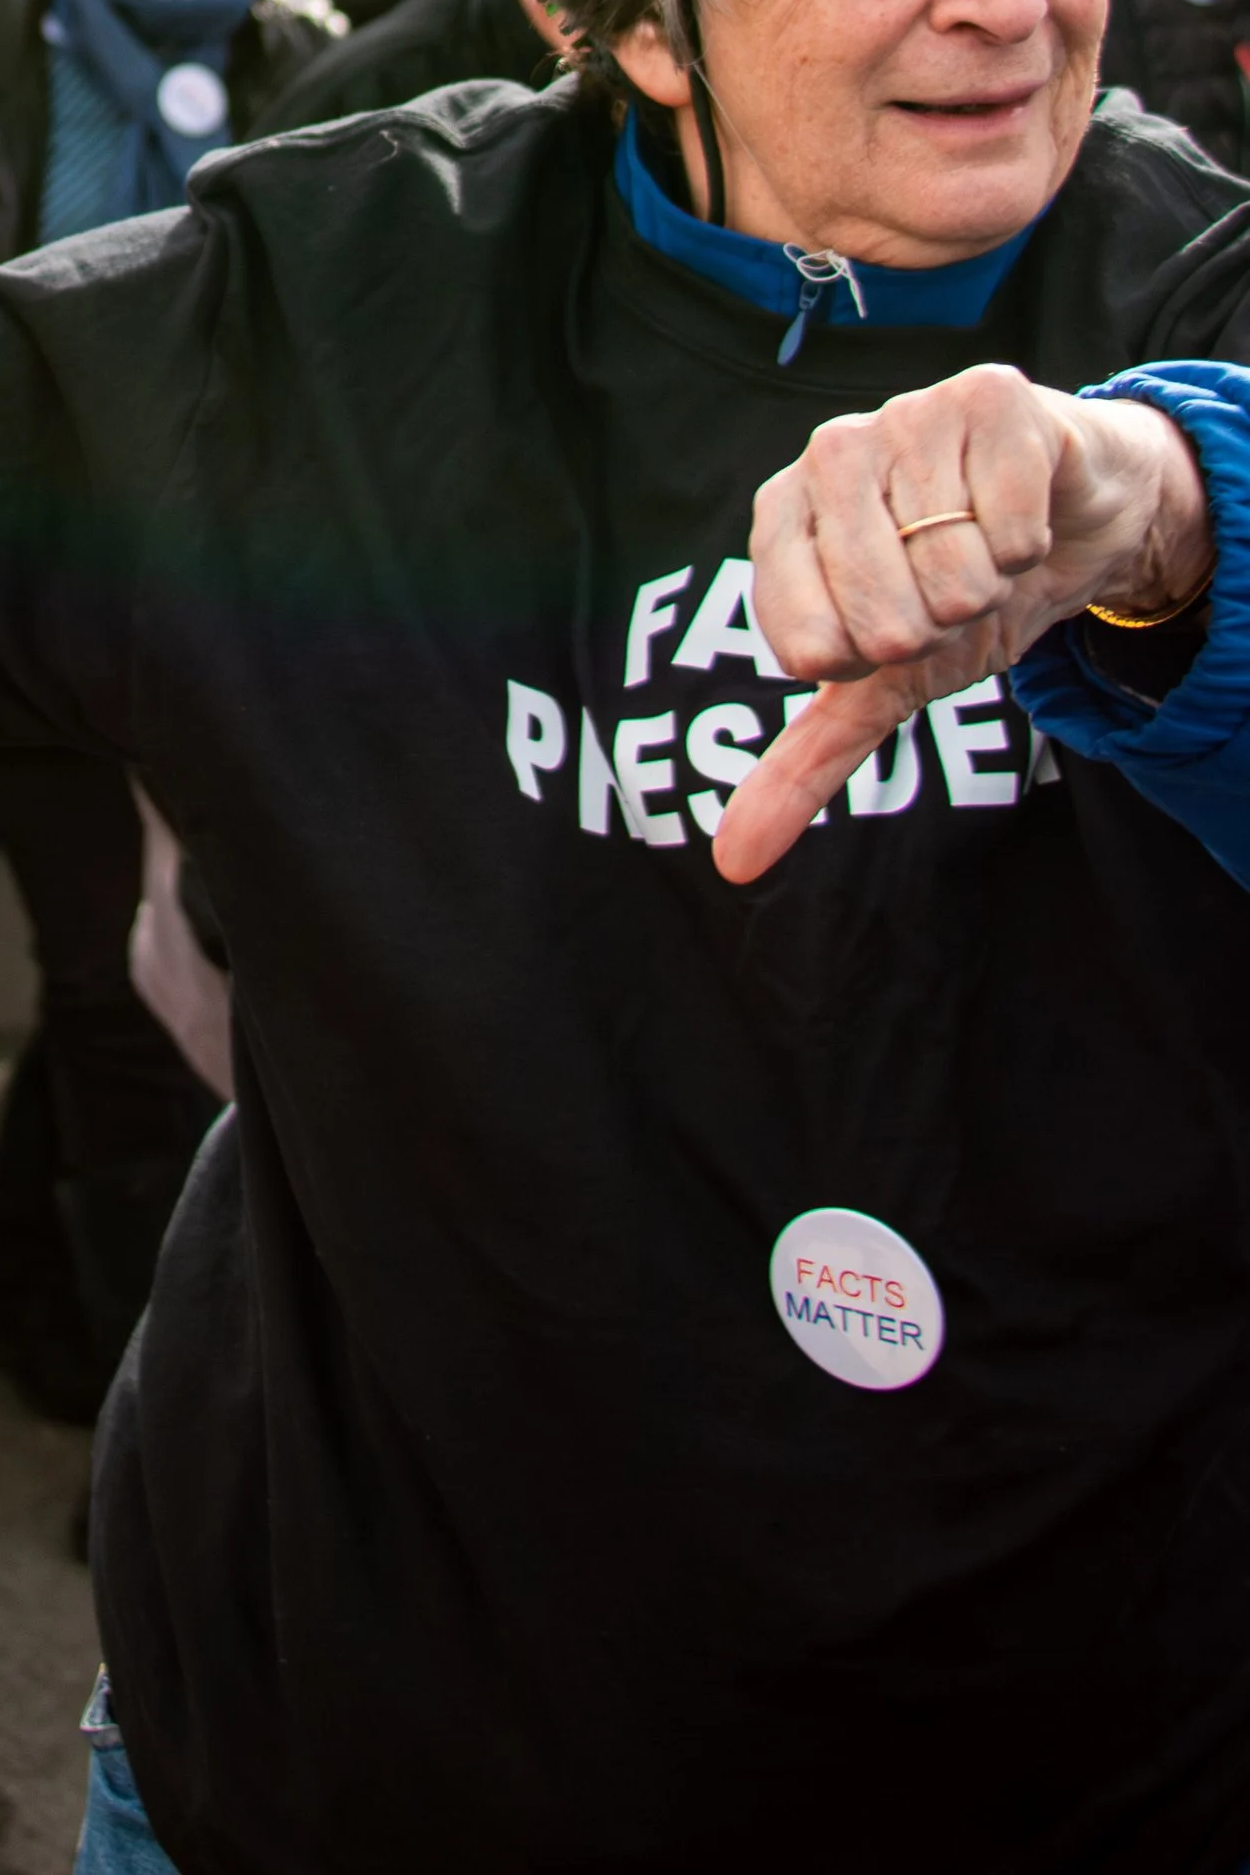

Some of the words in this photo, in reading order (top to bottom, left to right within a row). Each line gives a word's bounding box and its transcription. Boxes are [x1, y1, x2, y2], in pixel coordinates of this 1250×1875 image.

[623, 557, 796, 689] FA
[796, 1257, 907, 1309] FACTS
[784, 1290, 926, 1351] MATTER
